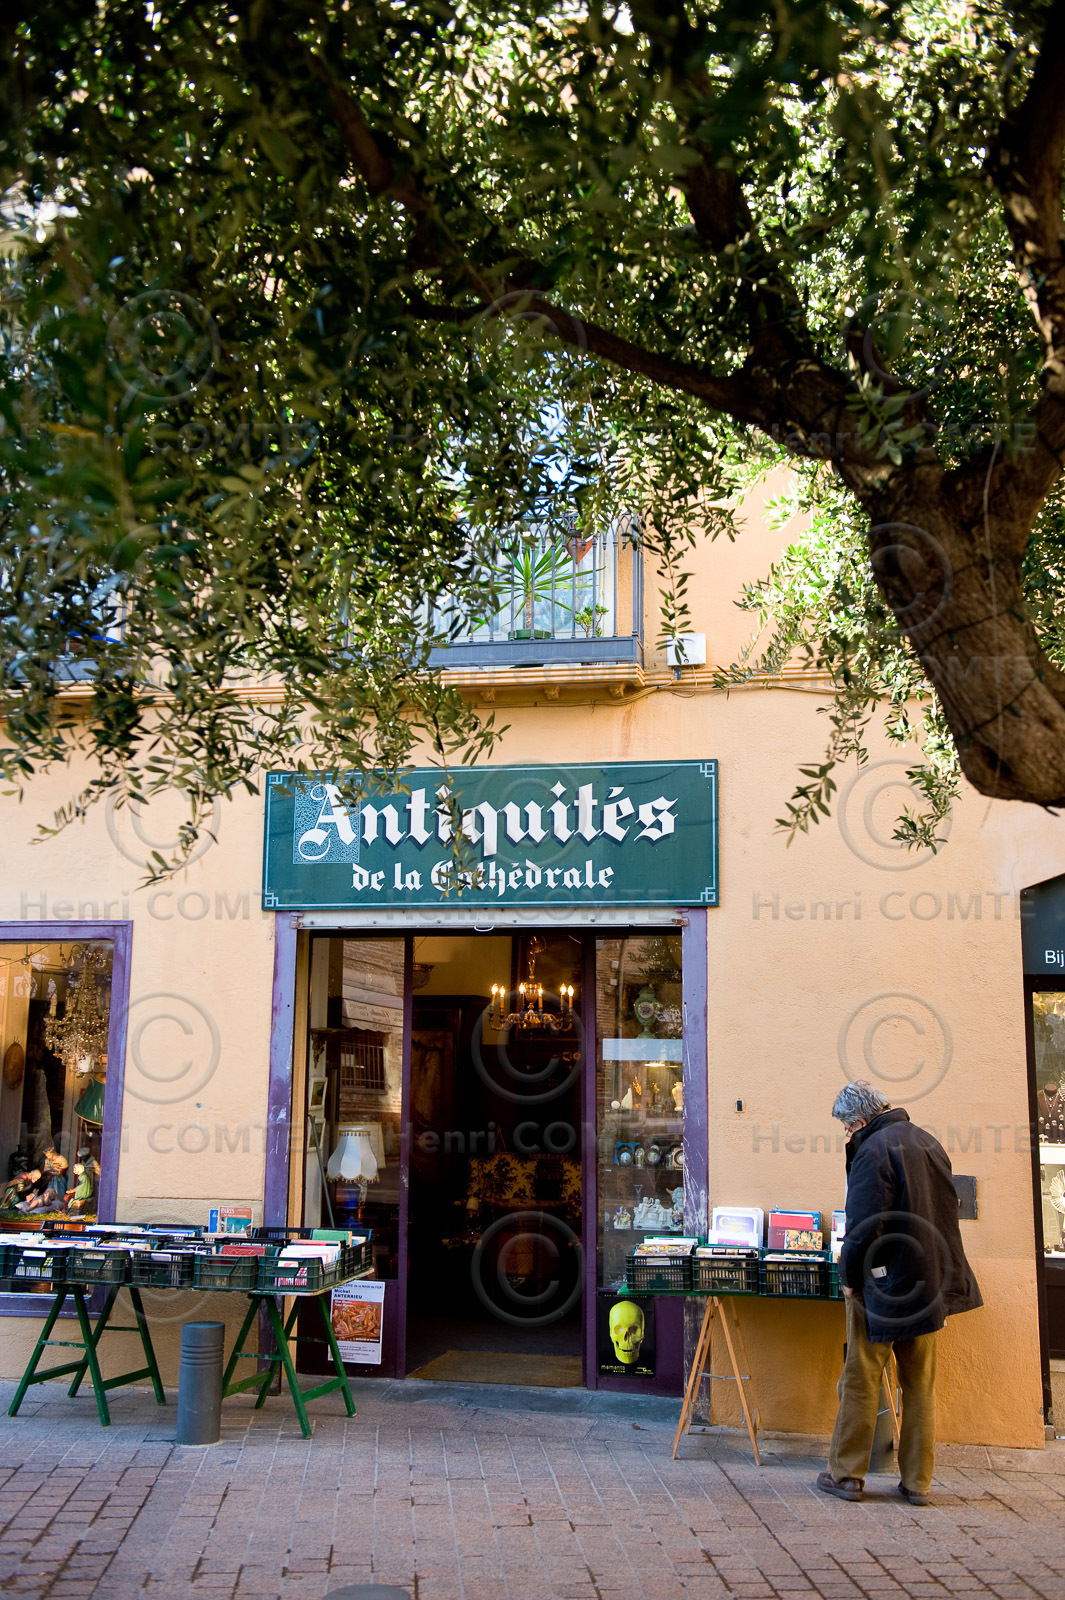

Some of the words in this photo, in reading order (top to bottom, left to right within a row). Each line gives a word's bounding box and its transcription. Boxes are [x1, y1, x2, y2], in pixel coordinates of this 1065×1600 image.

[298, 781, 679, 860] Antiquités
[351, 862, 386, 892] de
[393, 862, 424, 891] la
